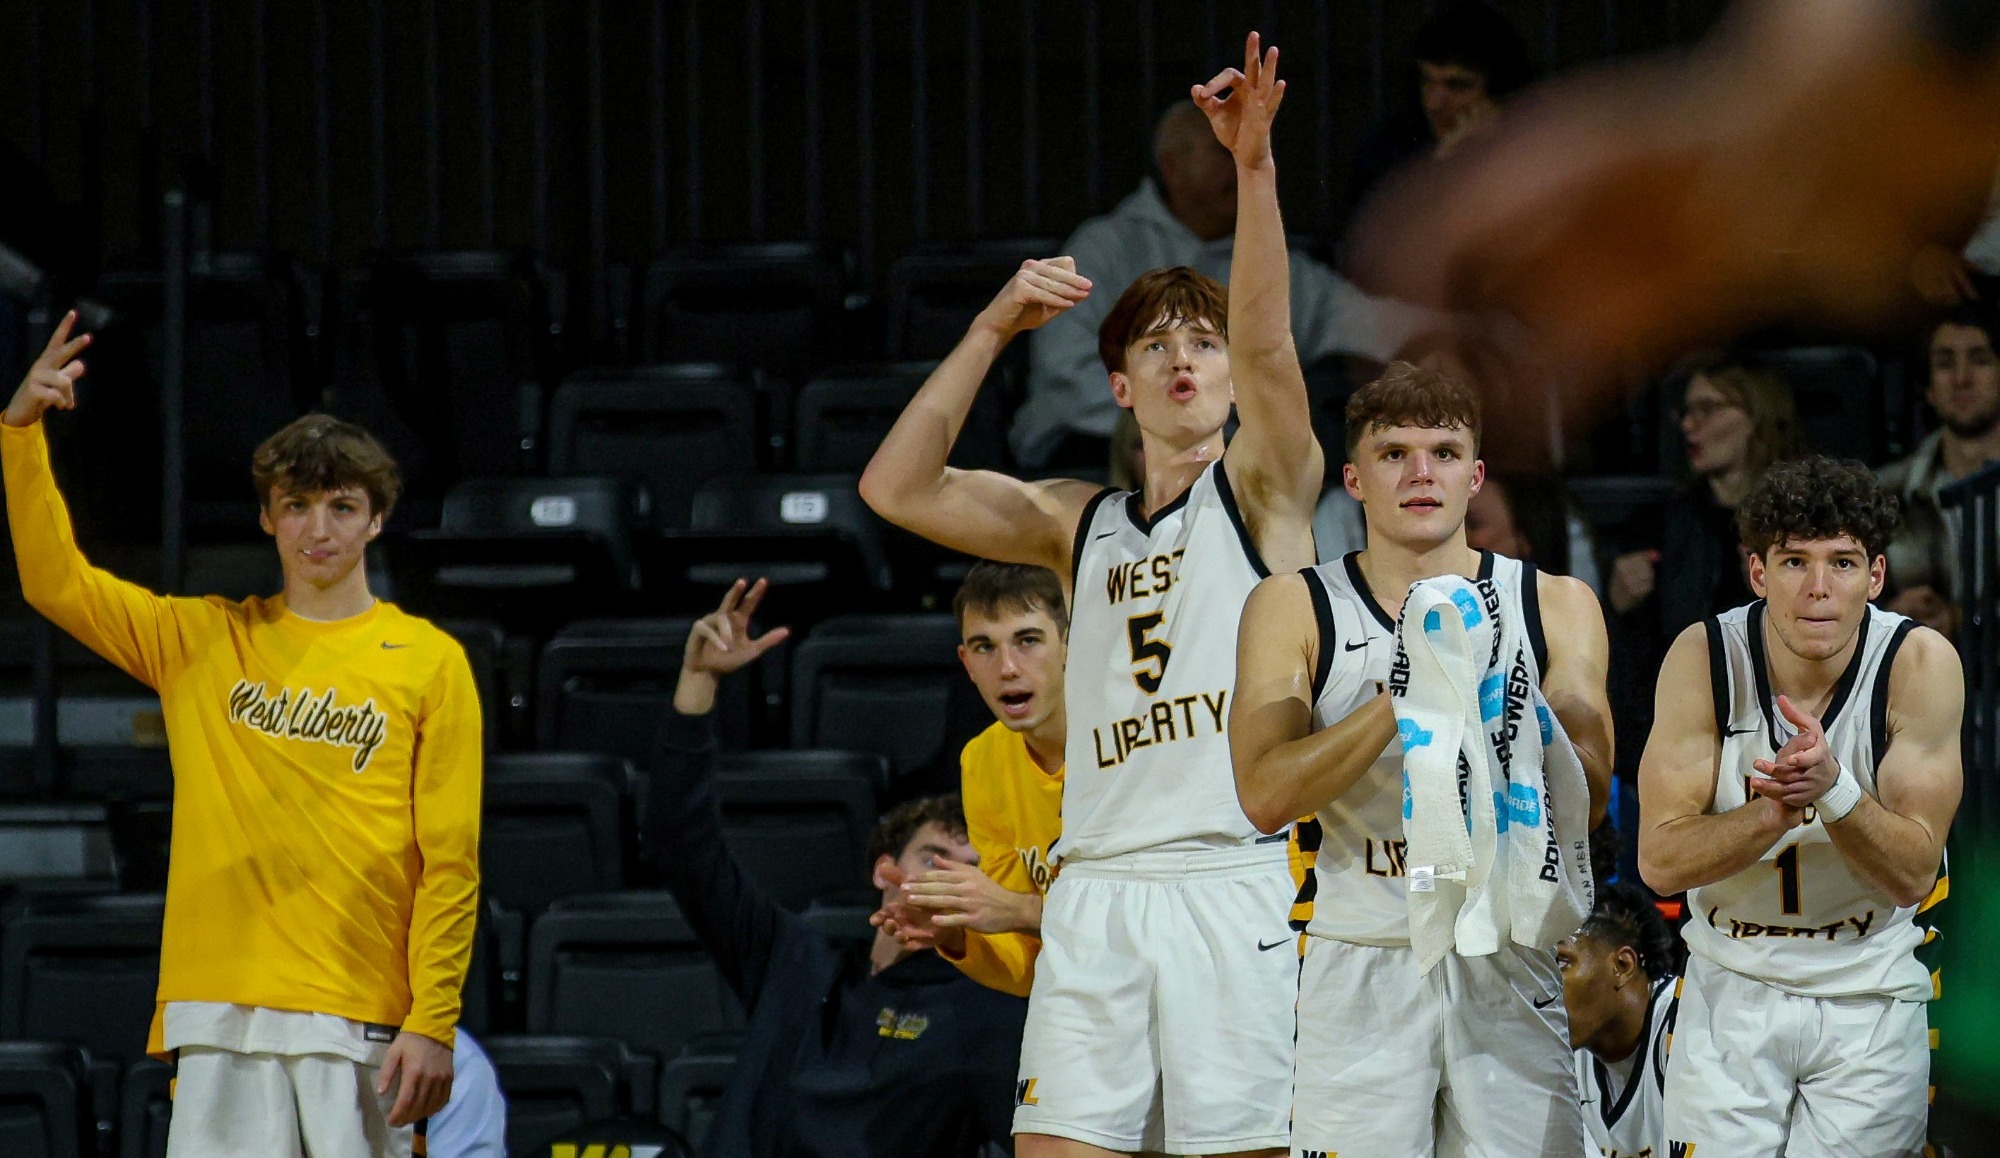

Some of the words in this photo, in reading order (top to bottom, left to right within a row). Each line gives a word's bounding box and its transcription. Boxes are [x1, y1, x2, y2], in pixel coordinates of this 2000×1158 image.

[1127, 610, 1174, 696] 5
[229, 680, 289, 736] West
[288, 687, 388, 773] Liberty
[1776, 842, 1802, 916] 1
